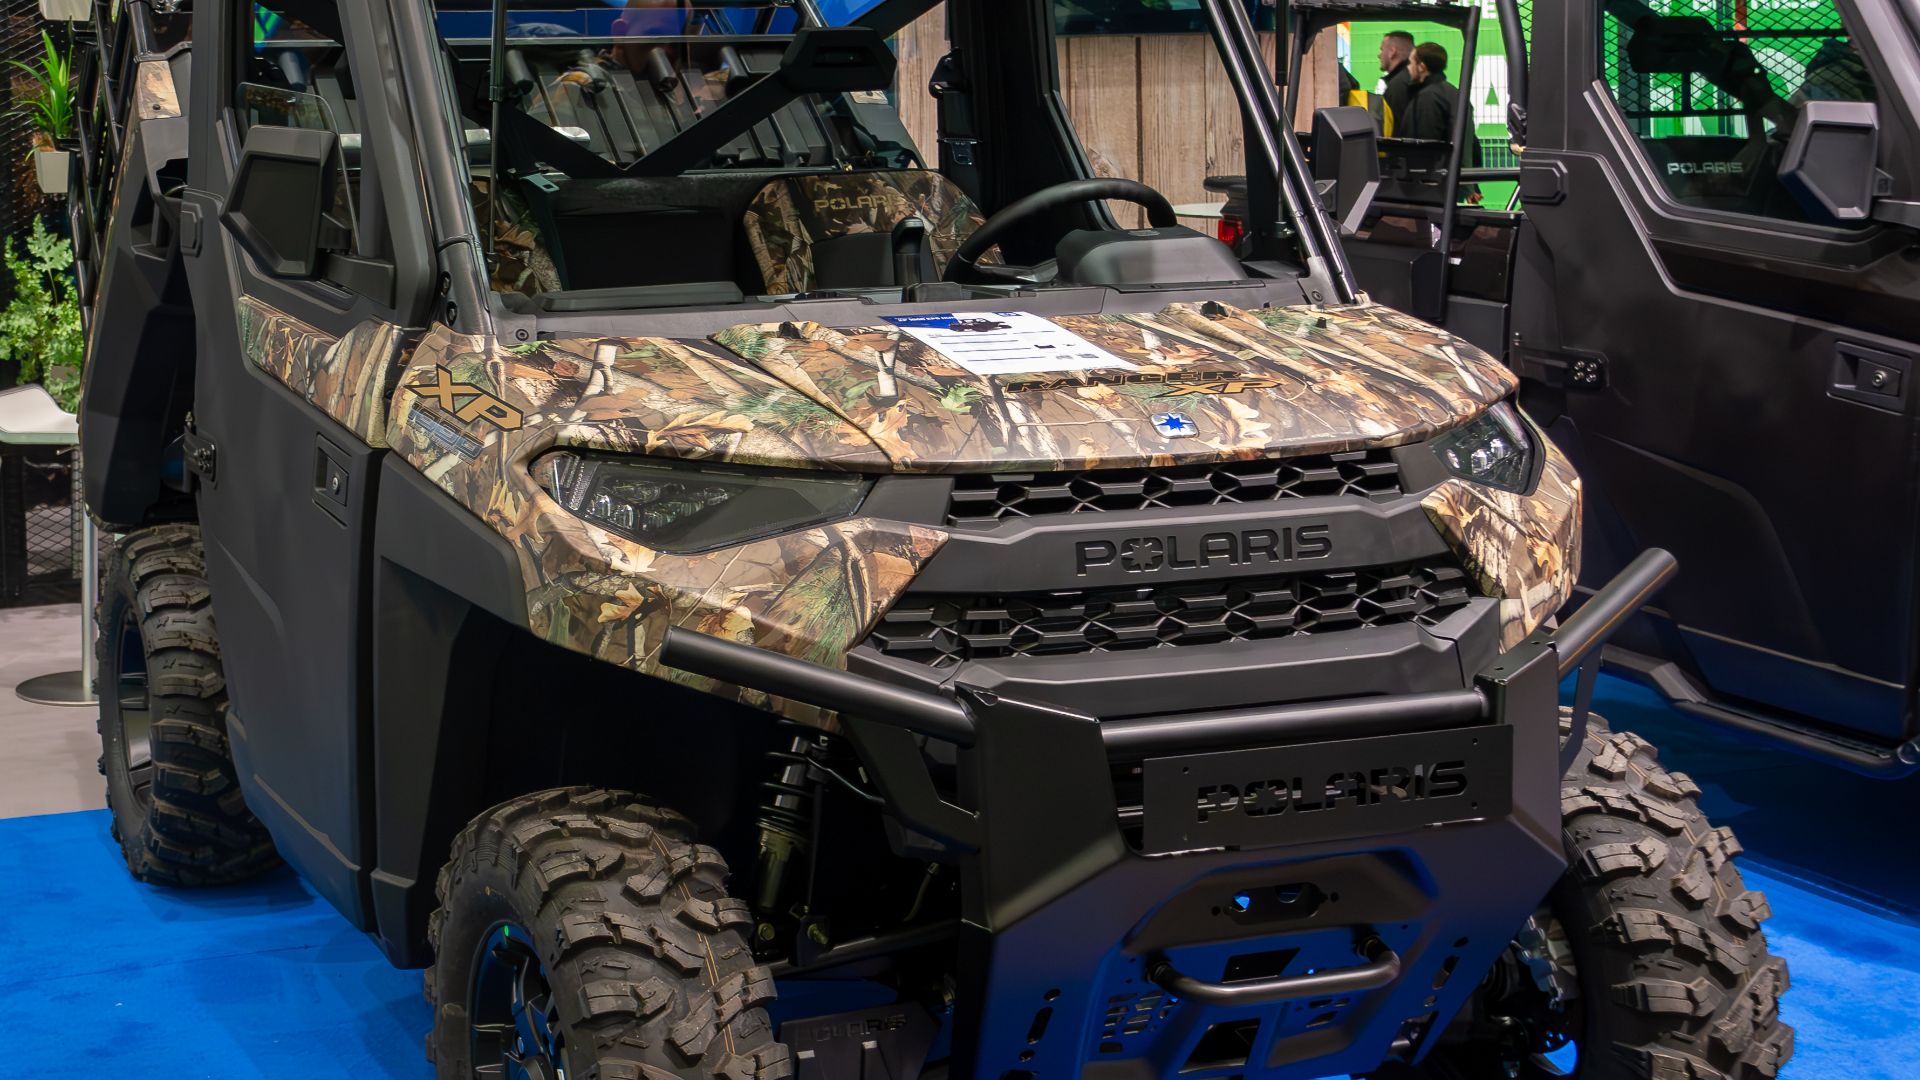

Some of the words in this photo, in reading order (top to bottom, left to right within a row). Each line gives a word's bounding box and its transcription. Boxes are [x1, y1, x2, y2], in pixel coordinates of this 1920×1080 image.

[1666, 162, 1744, 175] POLARIS
[403, 362, 524, 432] XP
[1005, 371, 1243, 394] RANGER
[1150, 378, 1287, 398] XP
[1075, 524, 1332, 577] POLARIS
[1197, 760, 1468, 823] POLARIS
